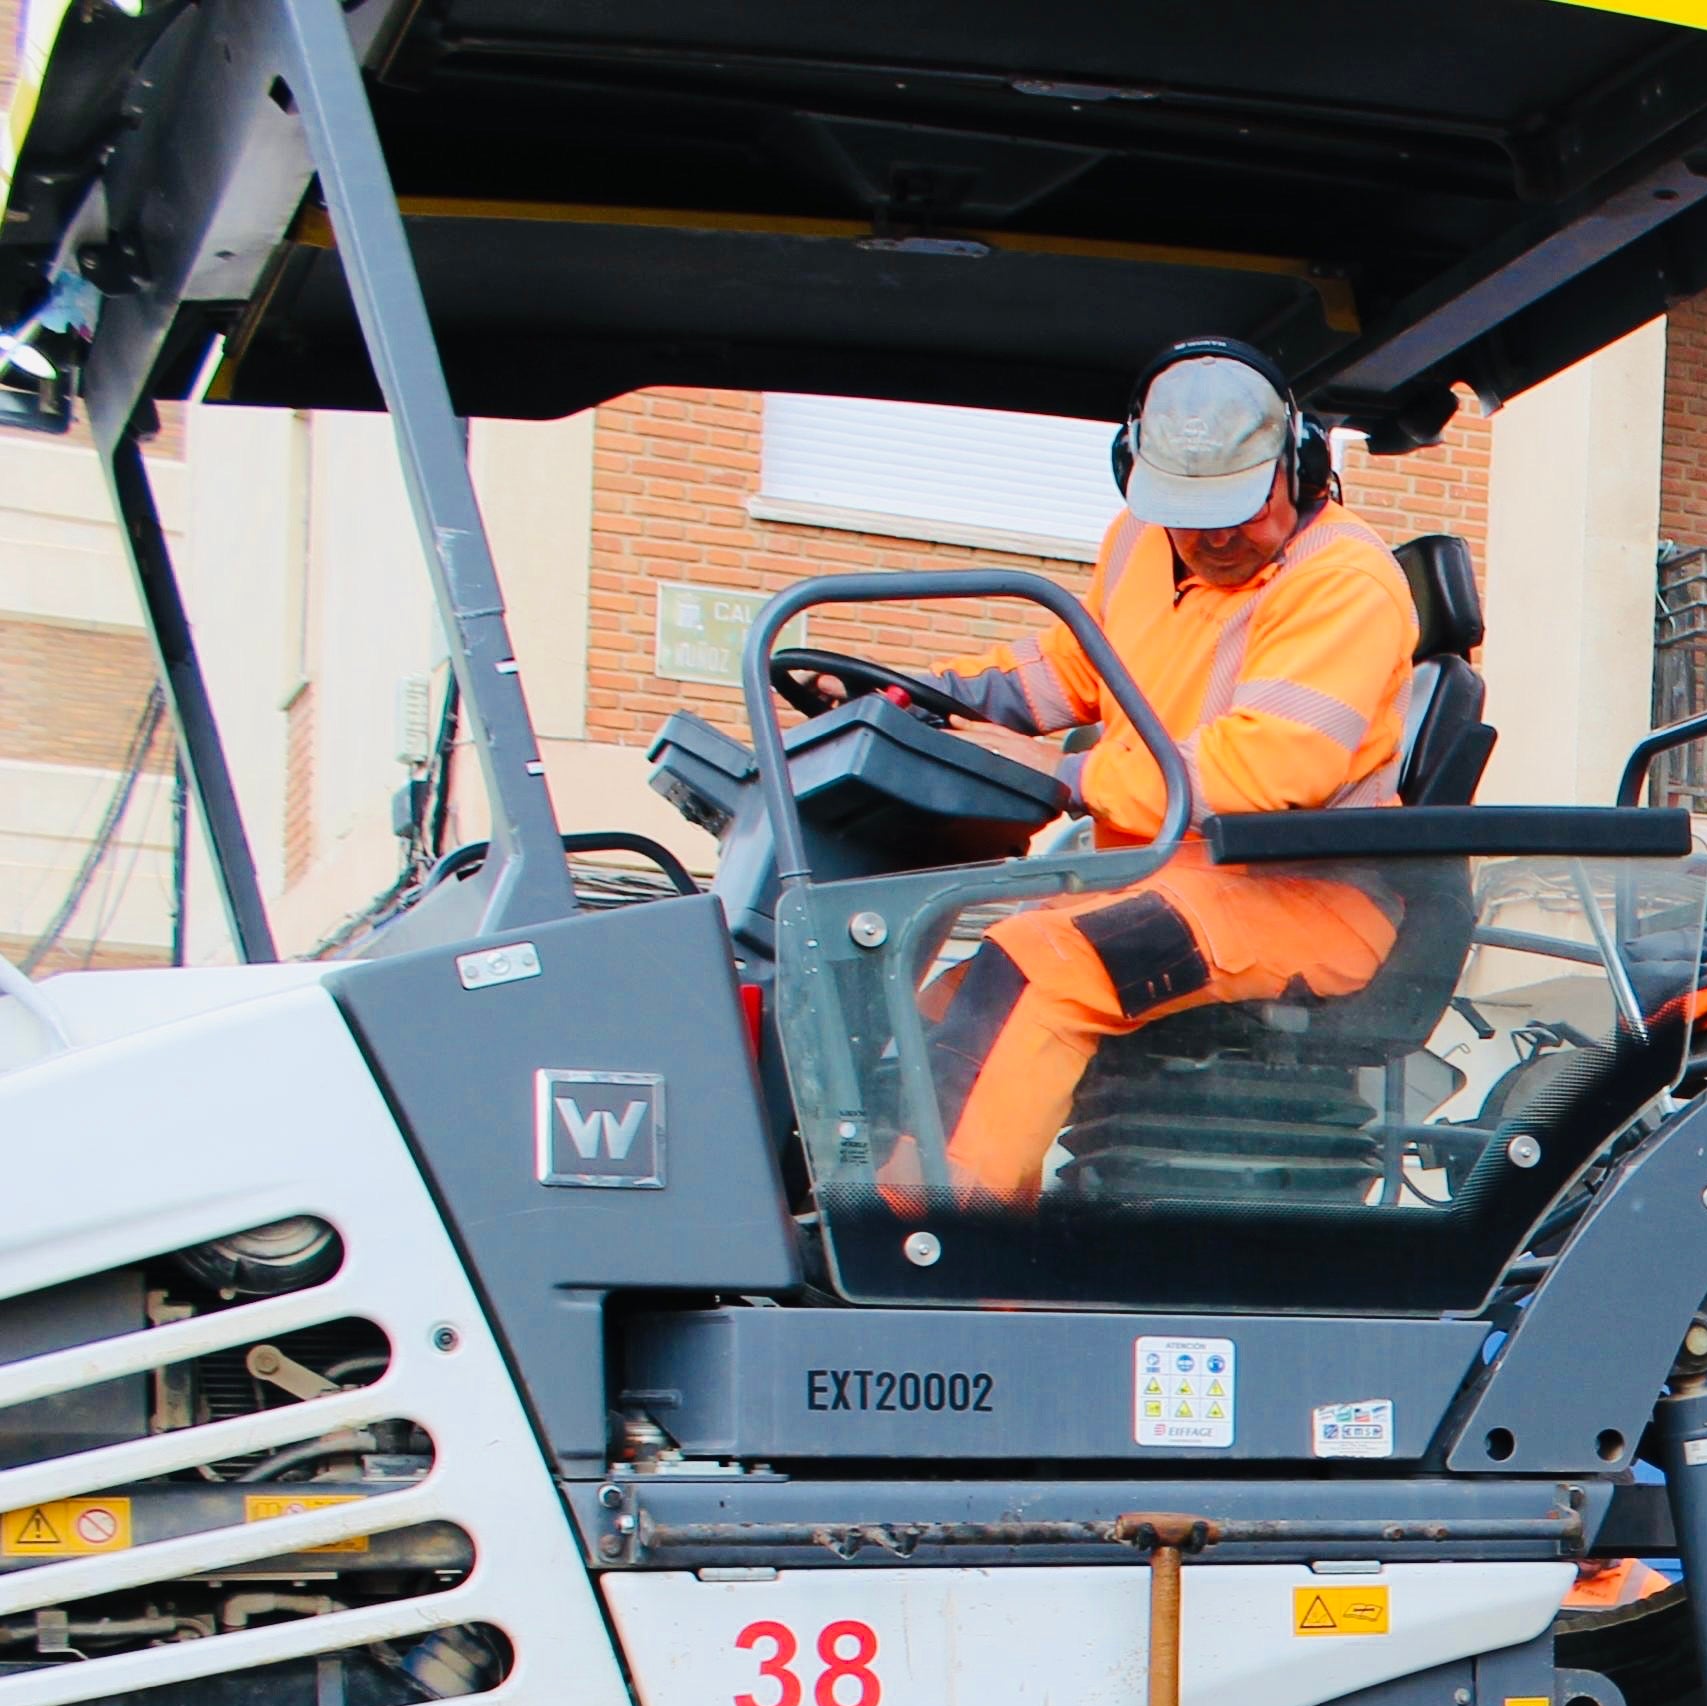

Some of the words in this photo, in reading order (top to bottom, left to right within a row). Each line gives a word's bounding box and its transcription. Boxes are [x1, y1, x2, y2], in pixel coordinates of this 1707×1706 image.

[714, 601, 754, 625] CAL
[807, 1369, 994, 1412] EXT20002
[1168, 1427, 1214, 1437] EIFFAGE
